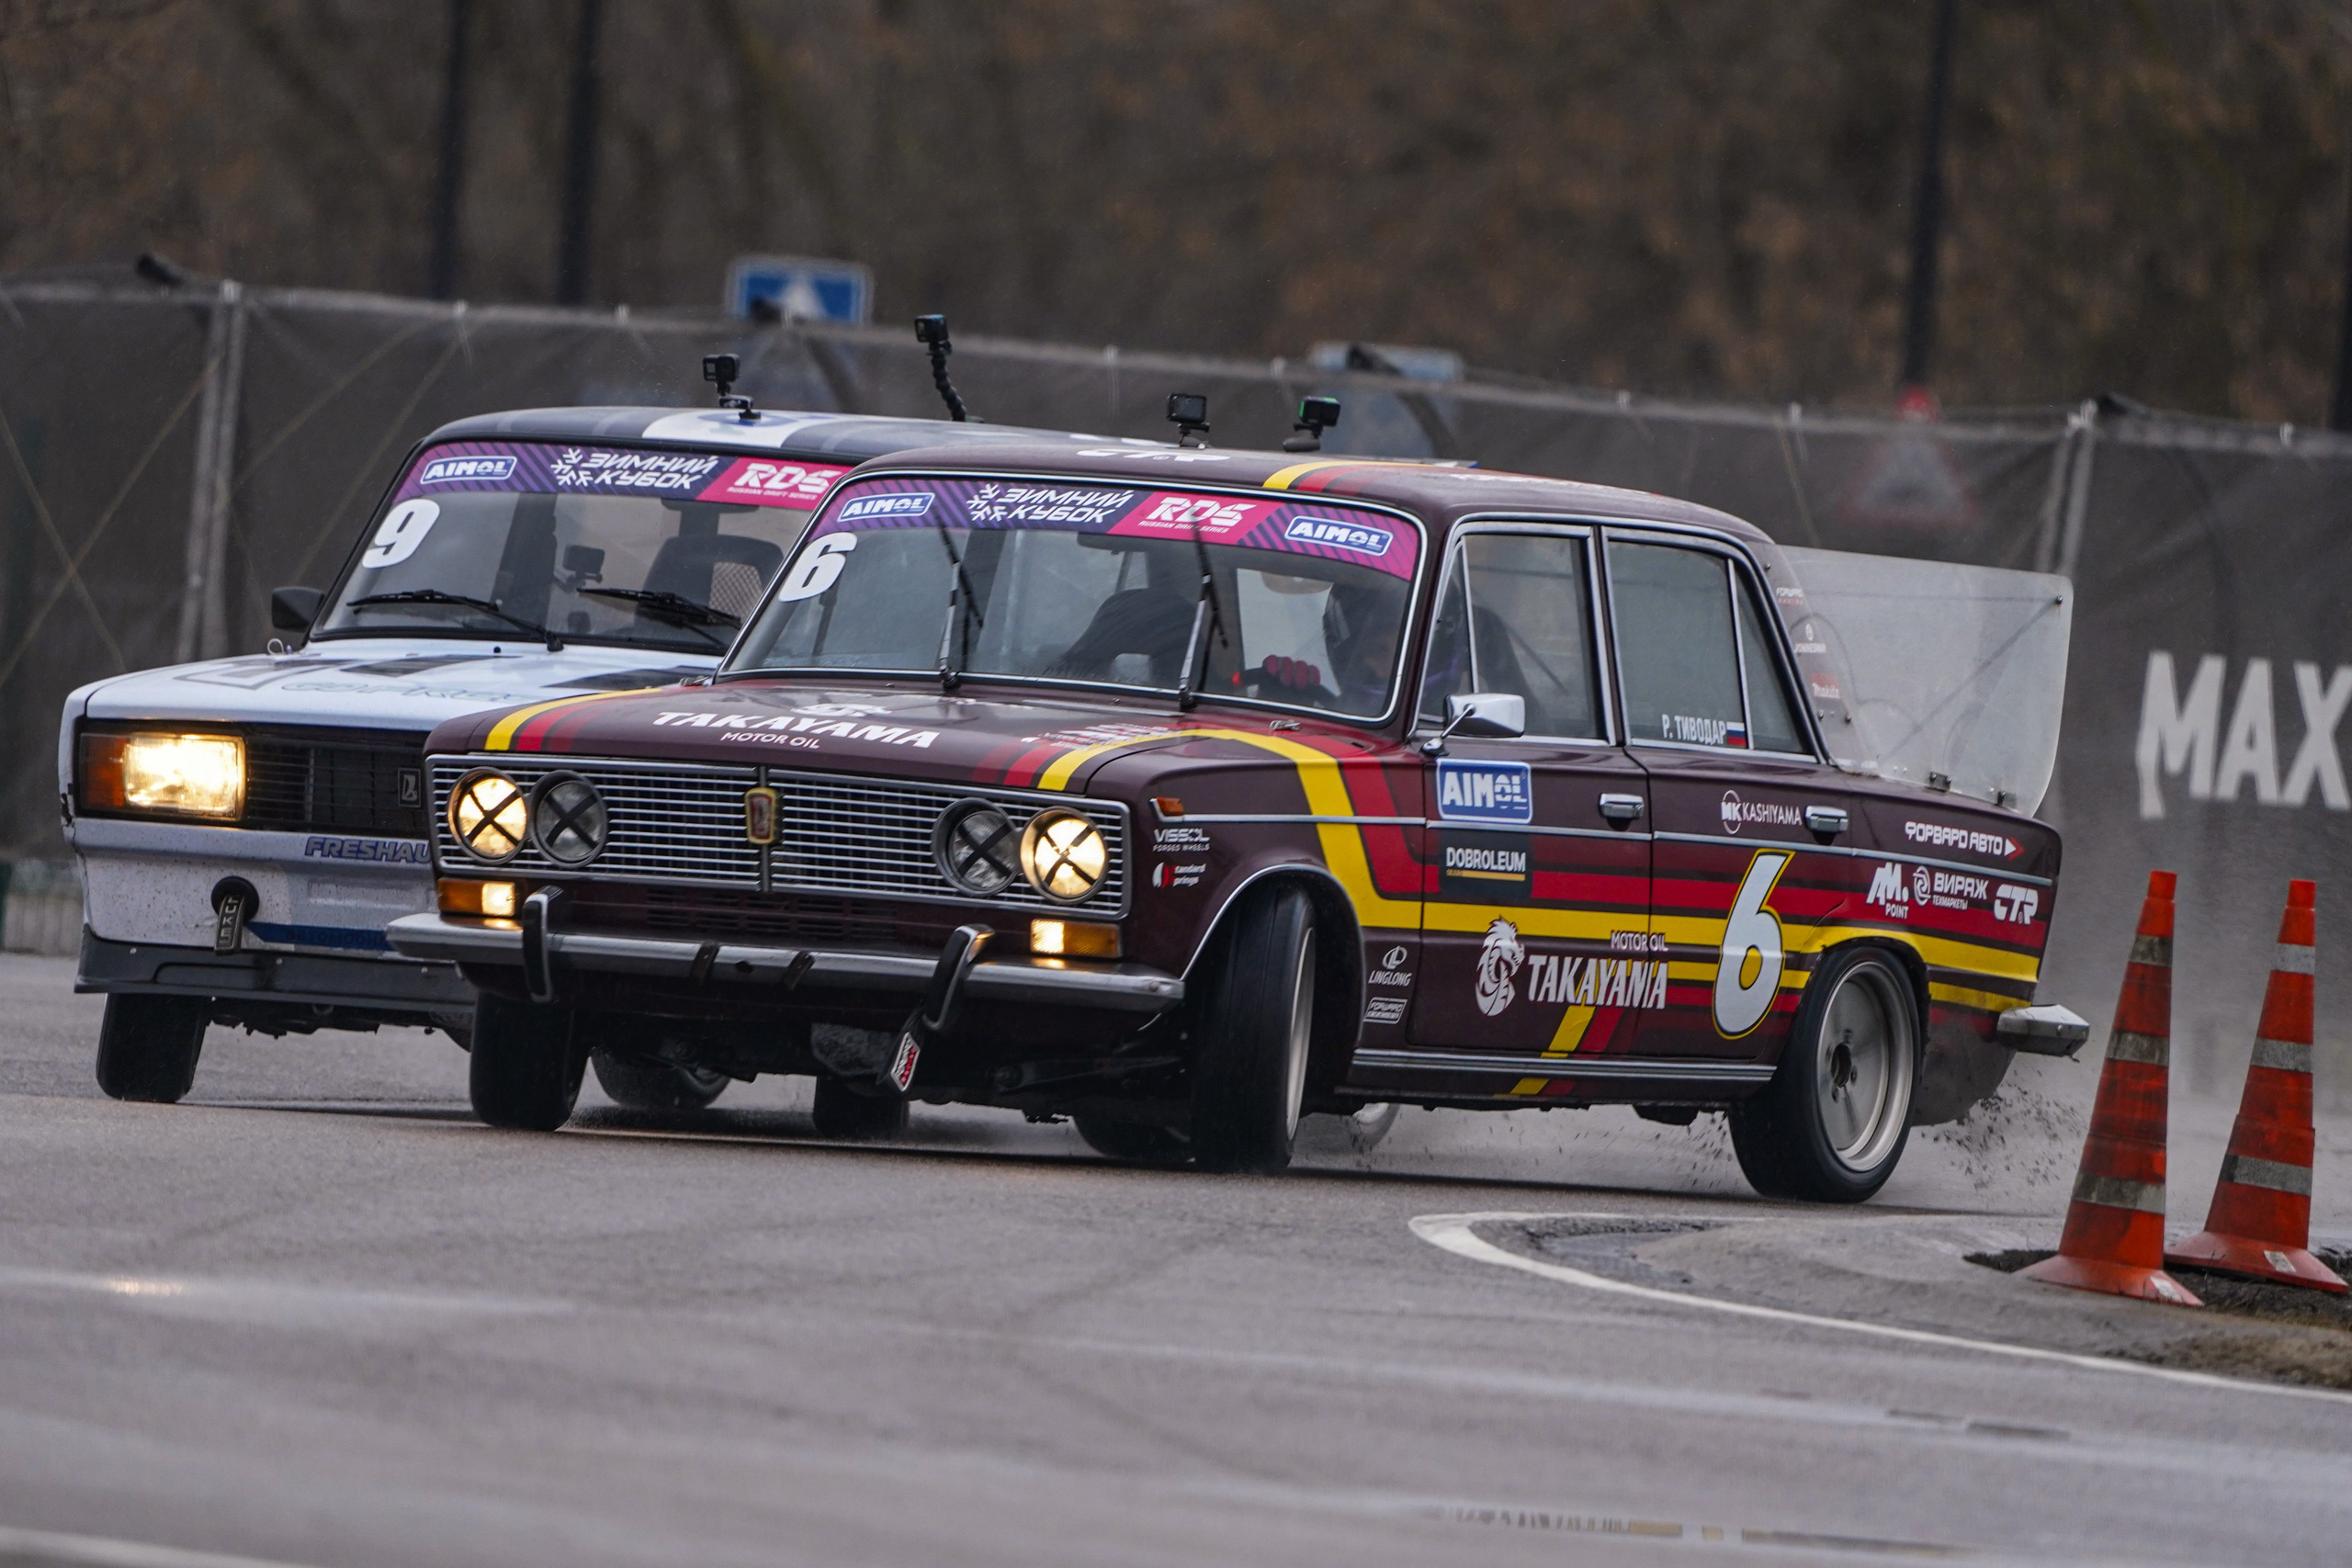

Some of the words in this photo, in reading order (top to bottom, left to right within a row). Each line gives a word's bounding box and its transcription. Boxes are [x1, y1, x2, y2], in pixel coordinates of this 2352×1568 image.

[424, 461, 507, 479] AIMOL
[581, 453, 718, 474] ЗИМНИЙ
[594, 470, 702, 490] КУБОК
[734, 463, 842, 493] RDS
[842, 497, 925, 517] AIMOL
[996, 488, 1136, 508] ЗИМНИЙ
[1008, 505, 1116, 524] КУБОК
[1146, 497, 1257, 527] RDS
[362, 498, 440, 569] 9
[1138, 520, 1175, 529] RUSSIAN
[1202, 525, 1230, 534] SERIES
[1290, 521, 1384, 549] AIMOL
[779, 532, 858, 603] 6
[652, 711, 941, 749] TAKAYAMA
[720, 731, 787, 744] MOTOR
[789, 736, 820, 750] OIL
[1661, 714, 1673, 739] Р.
[1674, 716, 1727, 746] ТИВОДАР
[1442, 772, 1528, 810] AIMOL
[1743, 802, 1803, 825] KASHIYAMA
[1905, 821, 1968, 849] ФОРВАРД
[1969, 832, 2003, 856] АВТО
[1446, 847, 1526, 872] DOBROLEUM
[1934, 872, 1990, 900] ВИРАЖ
[1885, 902, 1909, 919] POINT
[1932, 895, 1968, 911] ТЕХМАРКЕТЫ
[1994, 884, 2039, 925] CTR
[1611, 931, 1649, 952] MOTOR
[1649, 933, 1668, 952] OIL
[1713, 849, 1793, 1038] 6
[1368, 970, 1412, 987] LINGLONG
[1528, 954, 1668, 1010] TAKAYAMA
